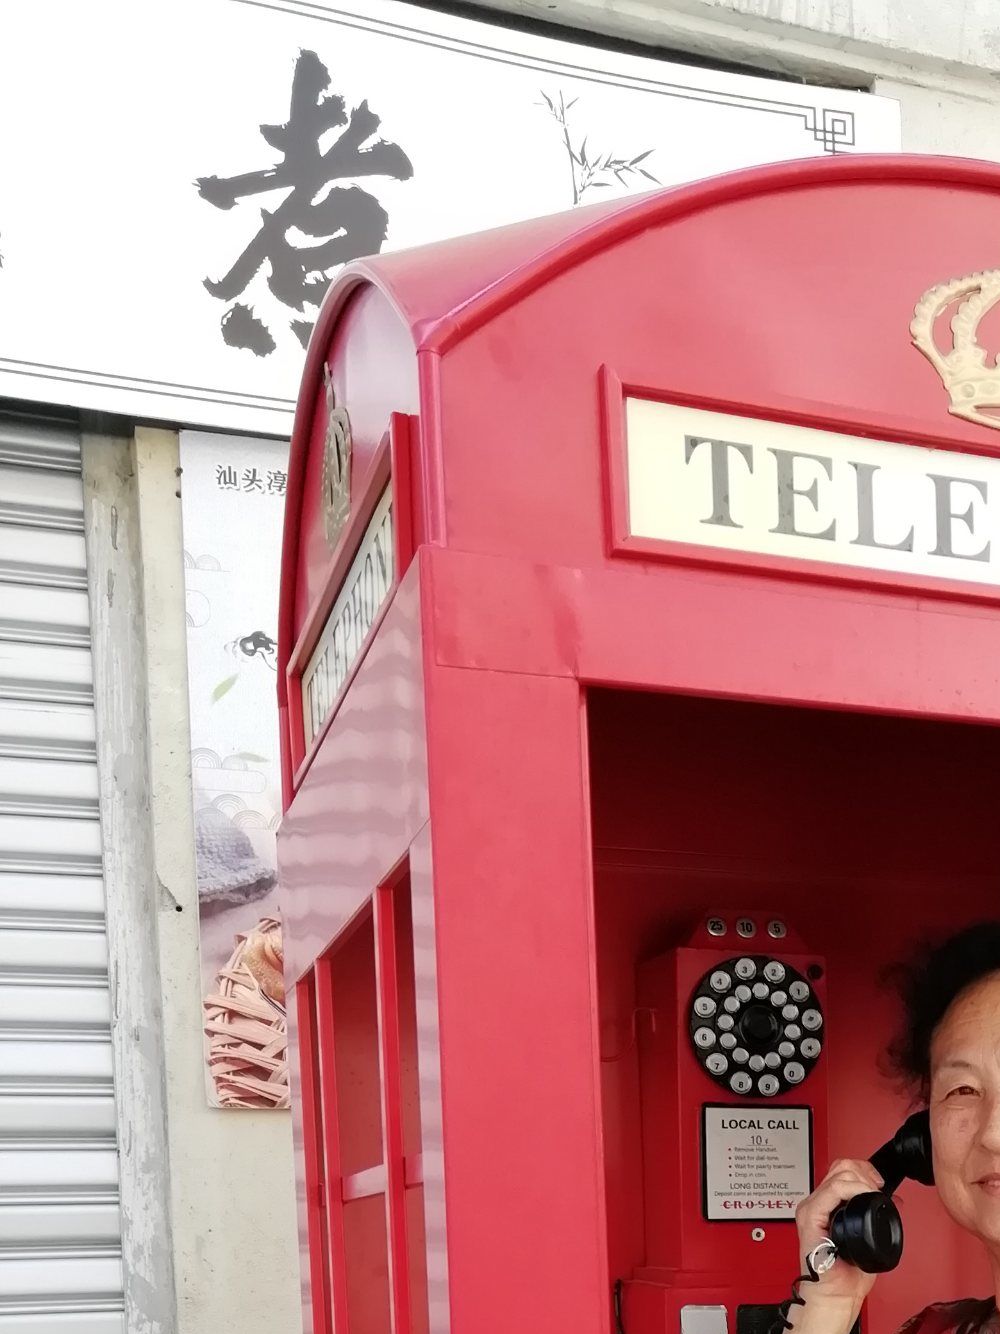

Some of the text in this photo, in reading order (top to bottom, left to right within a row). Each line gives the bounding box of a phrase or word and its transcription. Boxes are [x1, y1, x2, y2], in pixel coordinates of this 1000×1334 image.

[307, 503, 394, 738] TELEPHON
[710, 920, 722, 931] 25
[740, 921, 752, 933] 10
[773, 923, 780, 933] 5
[742, 966, 748, 974] 3
[771, 968, 777, 976] 2
[716, 977, 723, 986] 4
[702, 1003, 708, 1011] 5
[701, 1033, 707, 1041] 6
[714, 1062, 720, 1070] 7
[738, 1081, 744, 1089] 8
[765, 1083, 771, 1091] 9
[721, 1119, 800, 1130] LOCAL CALL
[751, 1135, 762, 1145] 10
[753, 1182, 789, 1190] DISTANCE
[723, 1200, 795, 1210] CROSLEY
